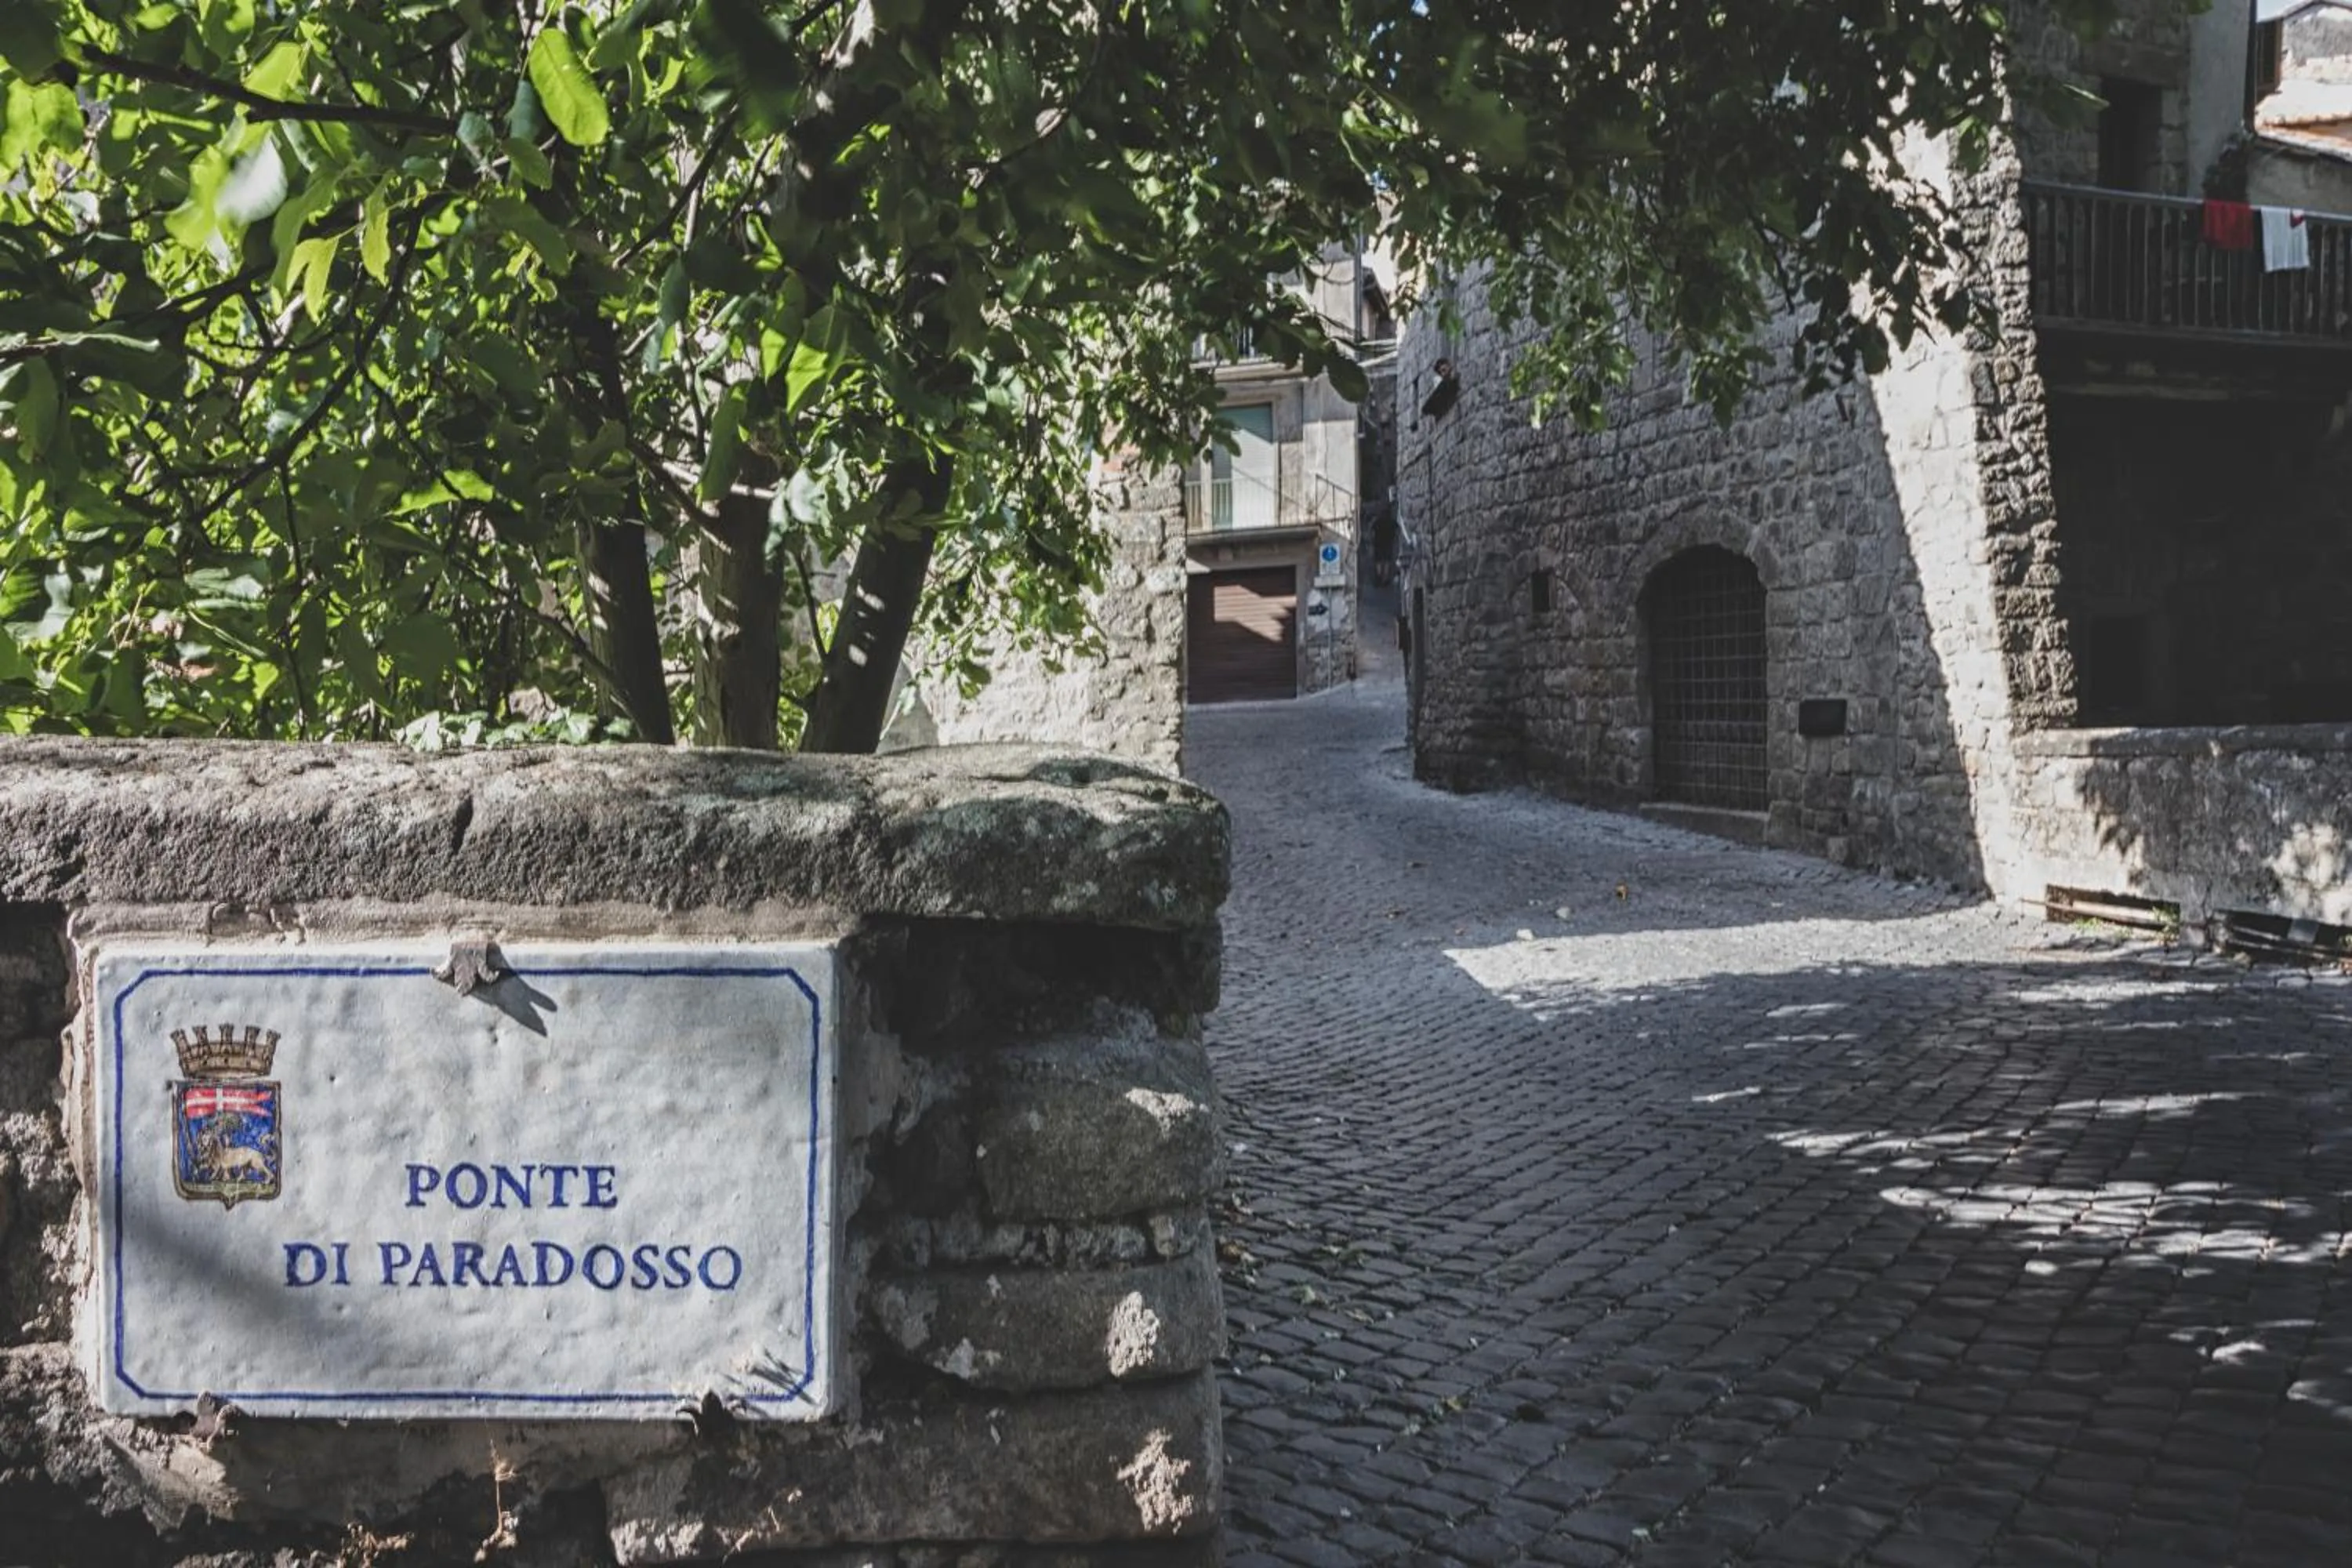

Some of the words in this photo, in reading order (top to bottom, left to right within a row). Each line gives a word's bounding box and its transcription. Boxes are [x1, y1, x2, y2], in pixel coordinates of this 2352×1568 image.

[405, 1163, 618, 1209] PONTE
[284, 1243, 350, 1287] DI
[378, 1242, 742, 1290] PARADOSSO
